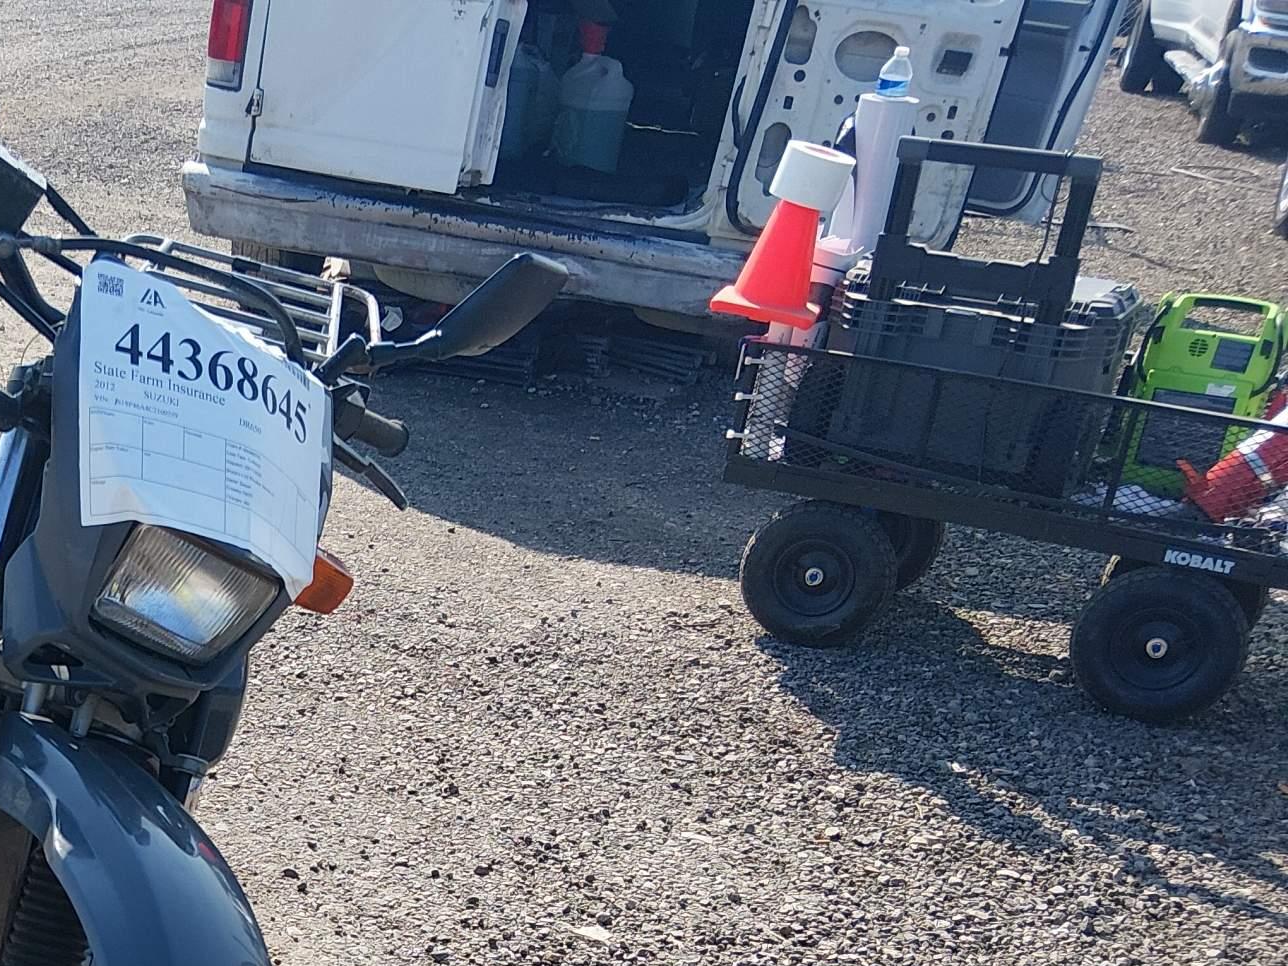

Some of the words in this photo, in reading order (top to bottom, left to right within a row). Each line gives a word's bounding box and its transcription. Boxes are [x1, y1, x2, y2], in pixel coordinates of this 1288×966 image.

[93, 360, 127, 381] State
[130, 368, 164, 390] Farm
[167, 378, 227, 407] Insurance
[93, 379, 116, 394] 2012
[143, 389, 181, 408] SUZUKI
[114, 322, 308, 444] 44368645
[1164, 549, 1237, 575] KOBALT
